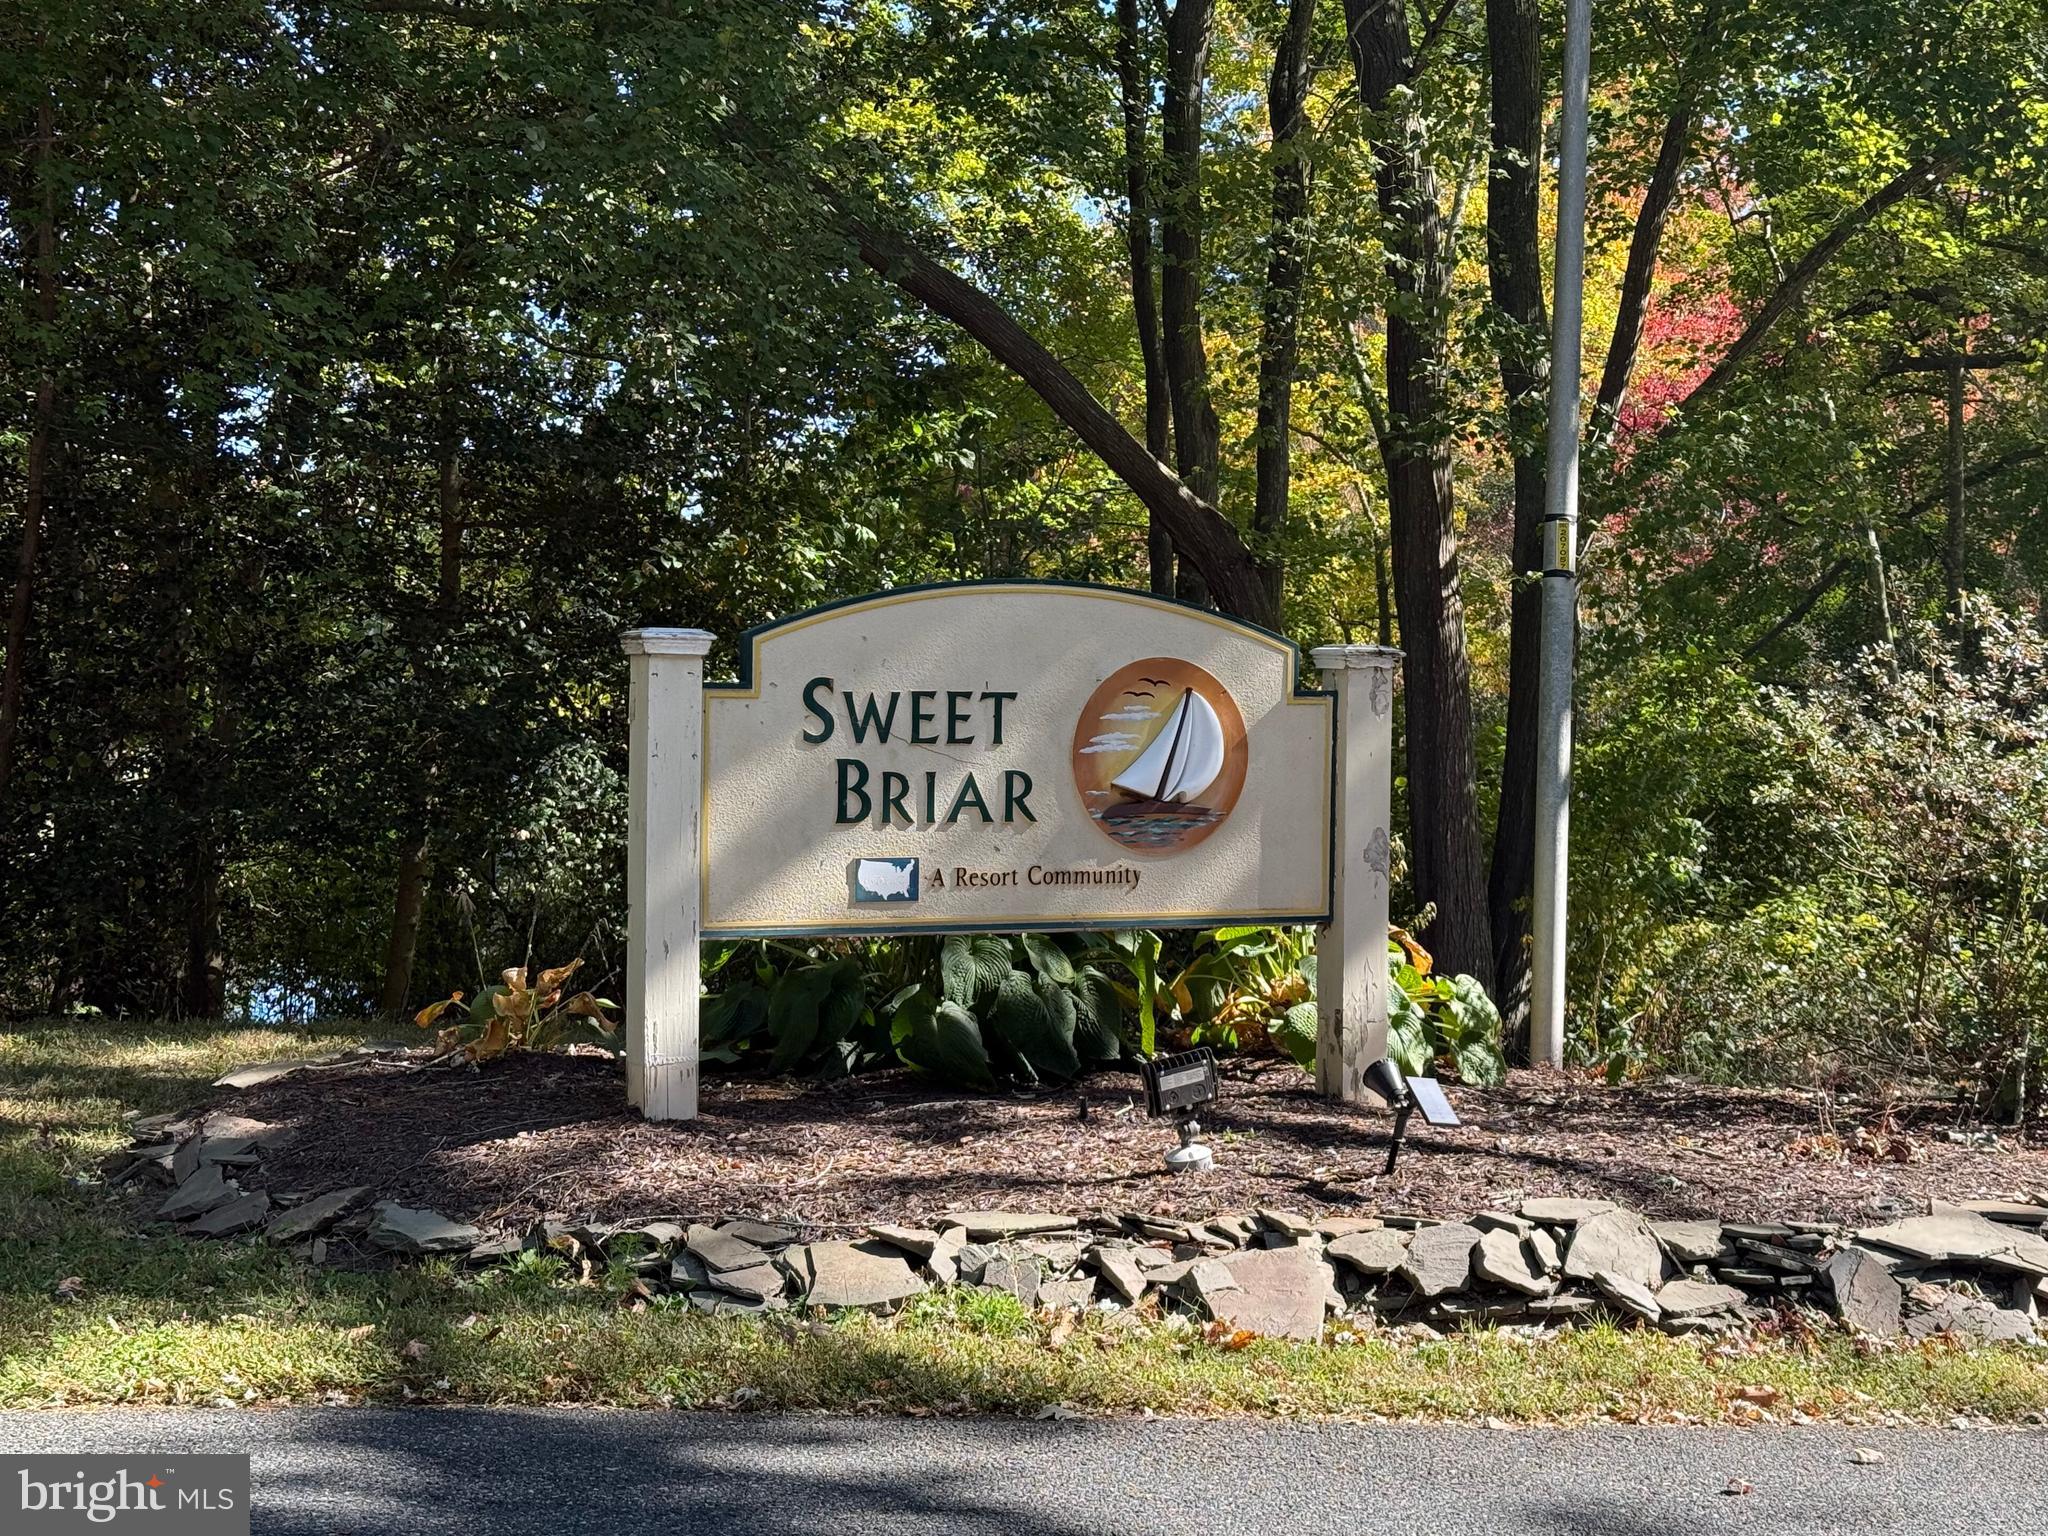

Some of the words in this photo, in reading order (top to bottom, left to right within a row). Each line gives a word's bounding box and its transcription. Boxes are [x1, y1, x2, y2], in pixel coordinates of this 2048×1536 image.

[803, 677, 1018, 744] SWEET
[836, 759, 1038, 824] BRIAR
[931, 867, 945, 887] A
[956, 867, 1018, 888] Resort
[1028, 865, 1141, 890] Community
